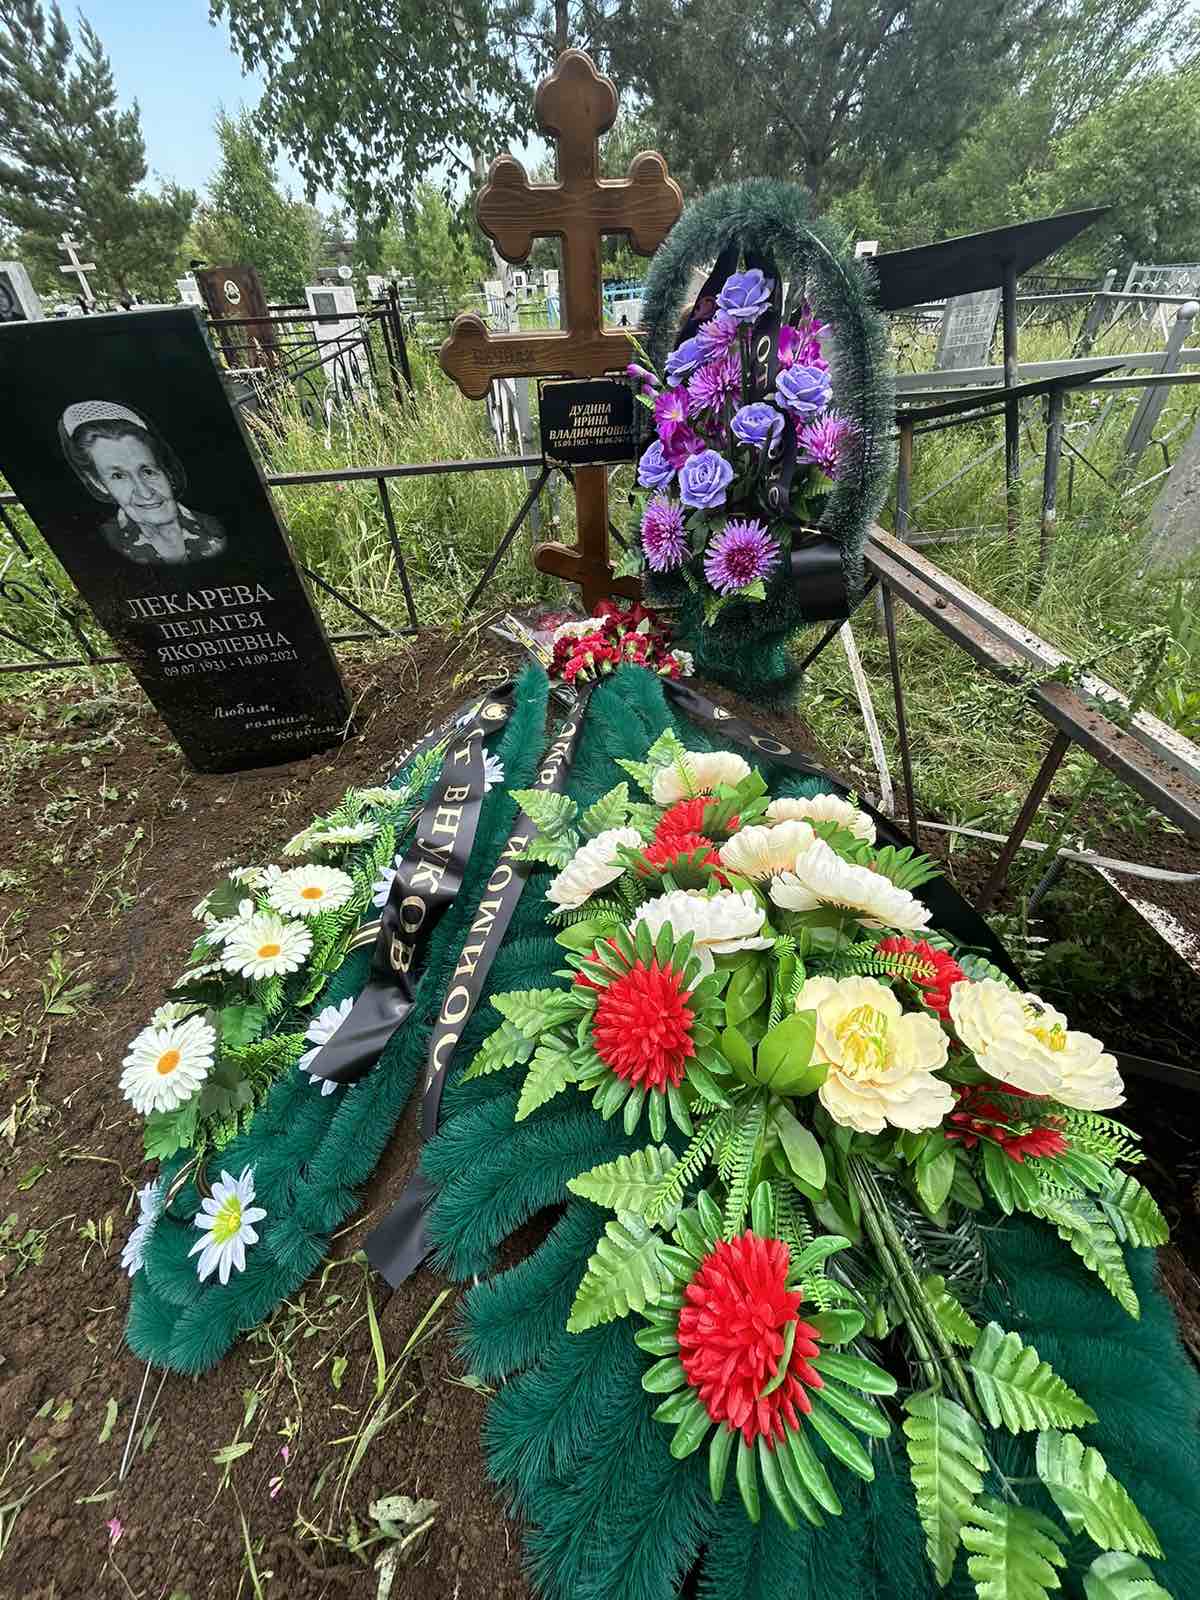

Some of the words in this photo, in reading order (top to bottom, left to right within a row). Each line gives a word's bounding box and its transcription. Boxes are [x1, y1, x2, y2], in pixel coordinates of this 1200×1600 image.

[569, 403, 612, 417] ДУДИНА
[573, 415, 609, 427] ИРИНА
[127, 584, 275, 619] ЛЕКАРЕВА
[159, 611, 266, 639] ПЕЛАГЕЯ
[158, 632, 292, 662] ЯКОВЛЕВНА
[164, 660, 227, 677] 09.07.1931
[238, 650, 298, 668] 14.09.2021
